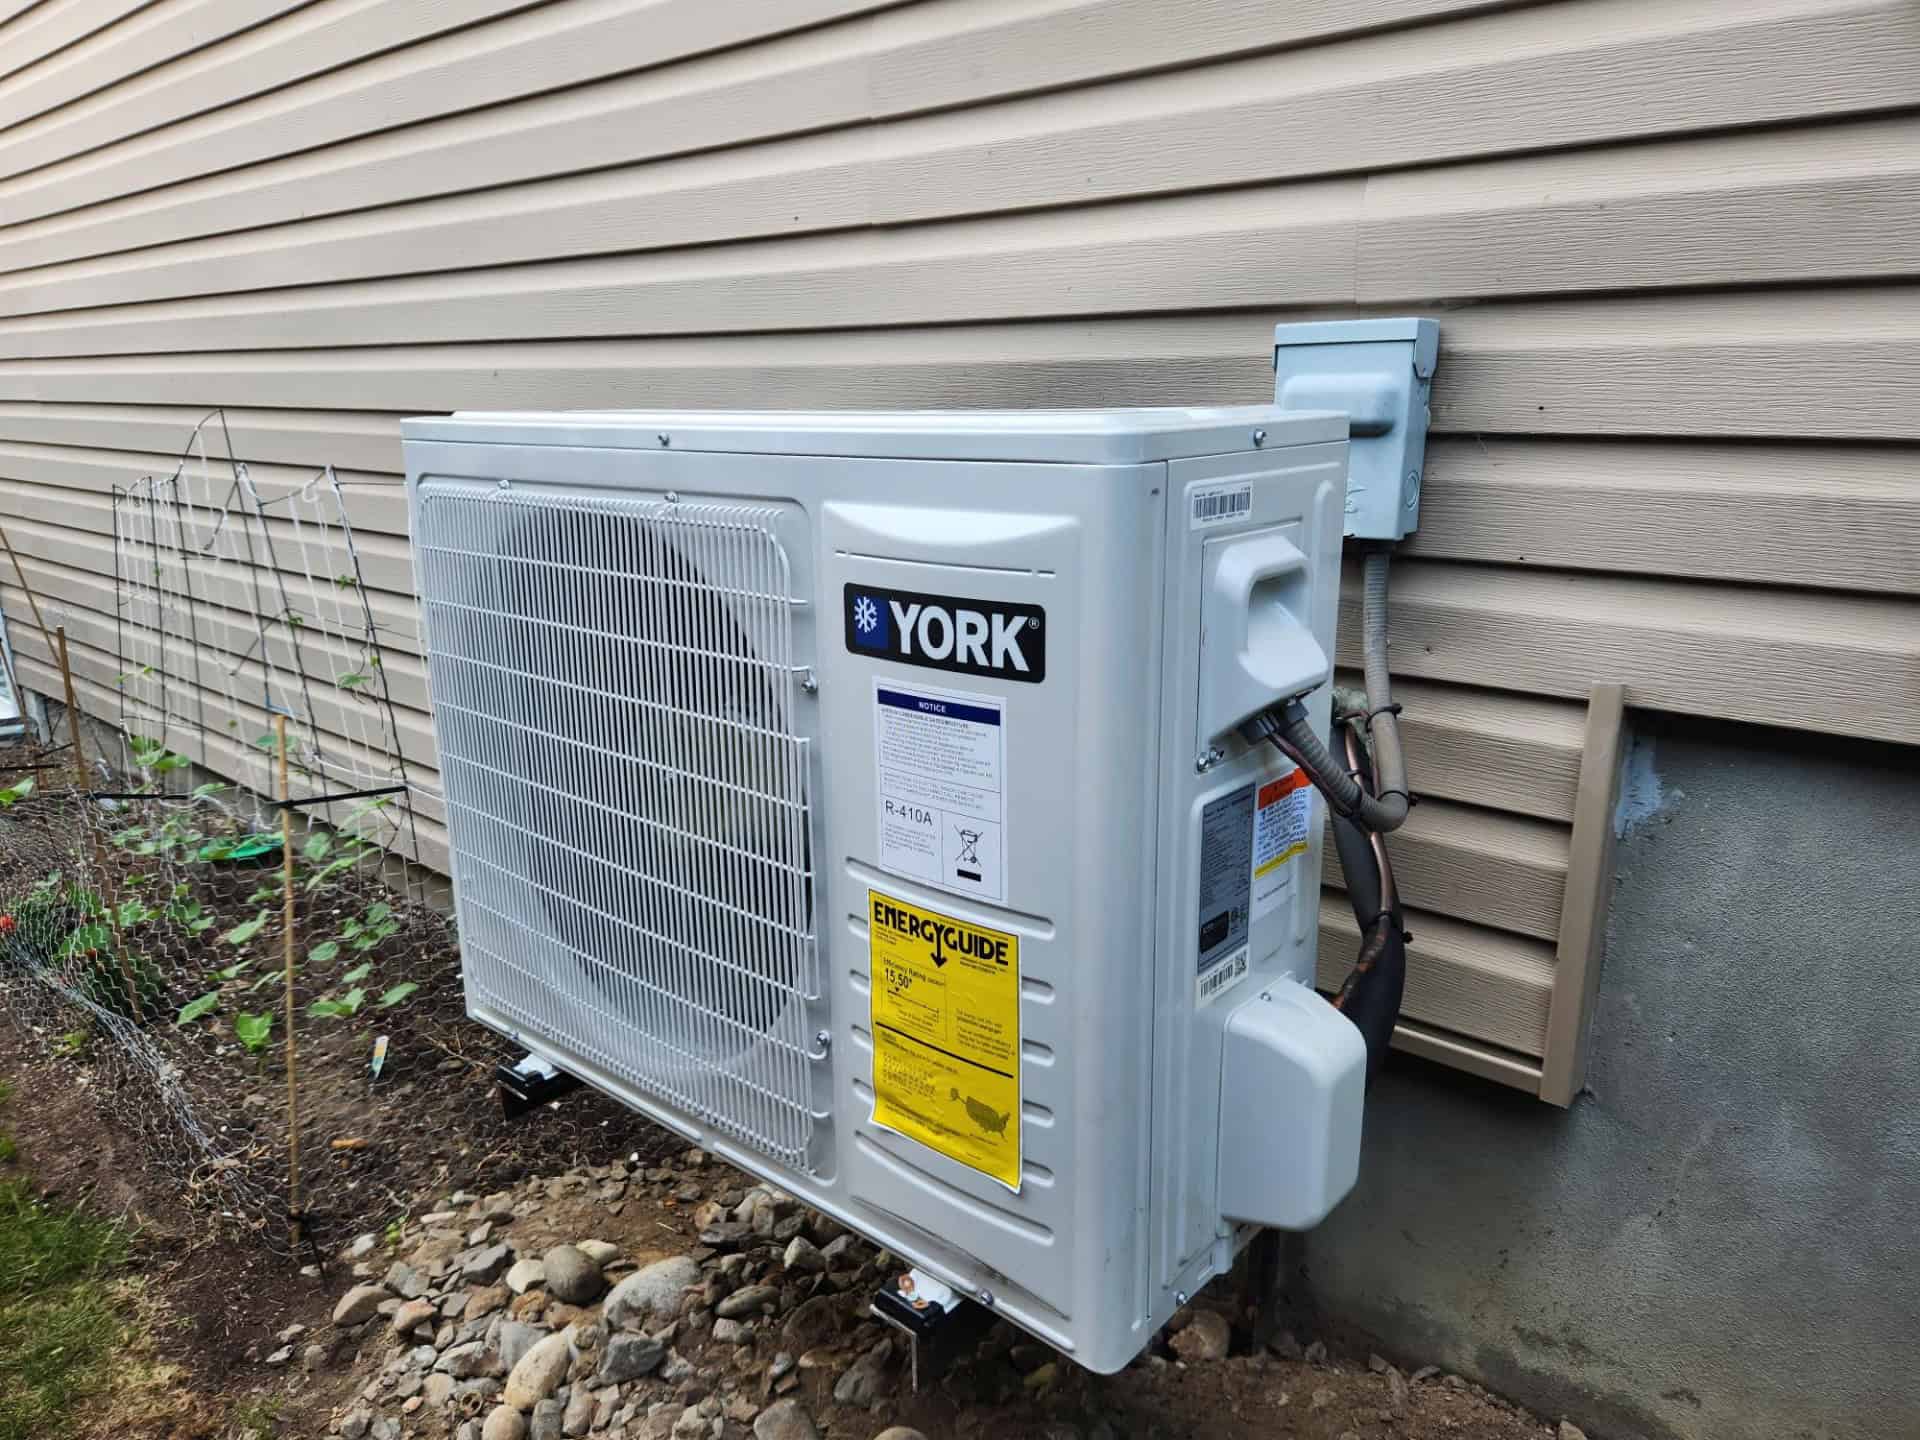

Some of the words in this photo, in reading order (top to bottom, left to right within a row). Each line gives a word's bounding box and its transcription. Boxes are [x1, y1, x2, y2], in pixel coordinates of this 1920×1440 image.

[889, 600, 1030, 672] YORK
[918, 701, 946, 713] NOTICE
[885, 799, 933, 826] R-410A
[873, 900, 1009, 967] ENERGYGUIDE
